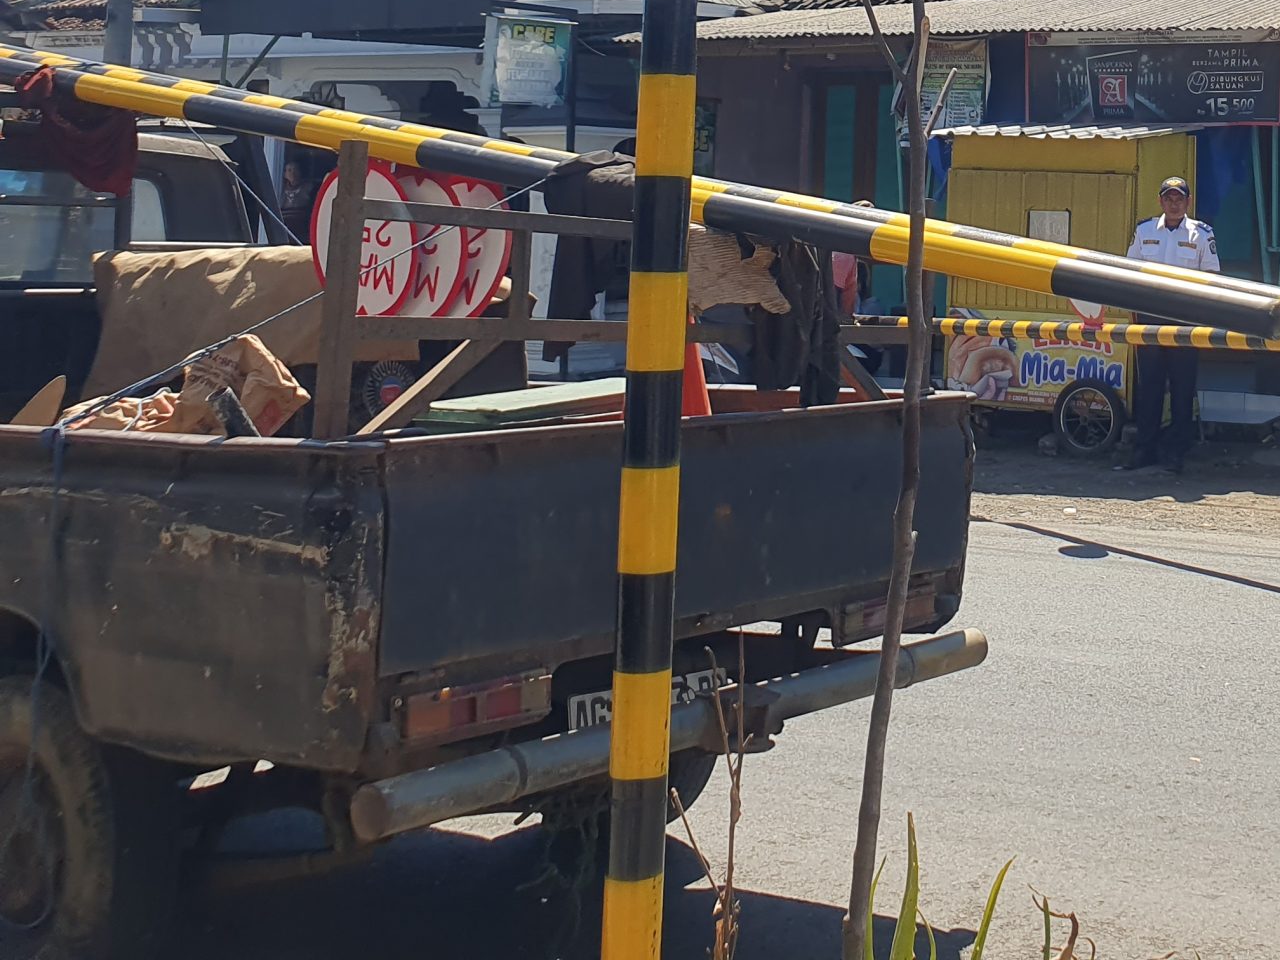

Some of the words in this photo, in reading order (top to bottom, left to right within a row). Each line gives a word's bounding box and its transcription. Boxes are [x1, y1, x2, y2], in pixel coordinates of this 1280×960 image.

[1208, 49, 1247, 58] TAMPIL
[1223, 58, 1259, 67] PRIMA
[1021, 351, 1123, 388] Mia-Mia
